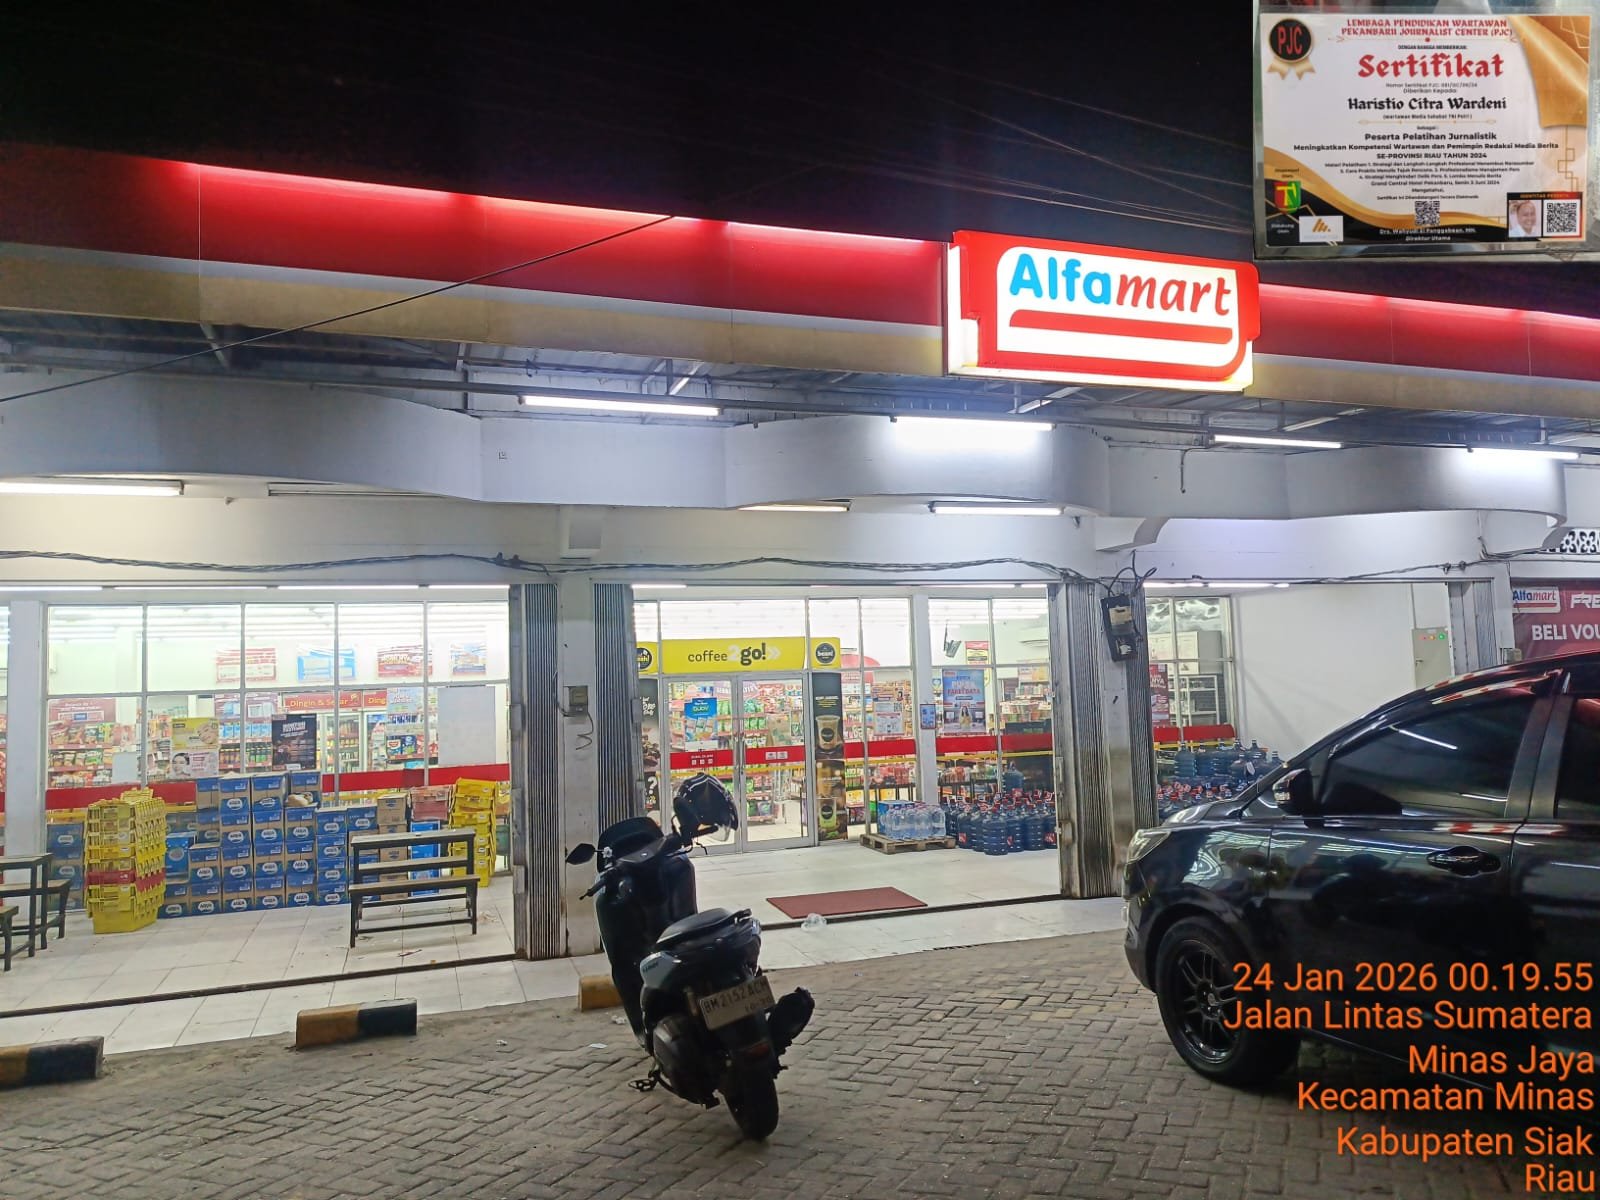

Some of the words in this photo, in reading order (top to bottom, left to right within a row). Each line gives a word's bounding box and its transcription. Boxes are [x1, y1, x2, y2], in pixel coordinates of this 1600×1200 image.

[1009, 253, 1232, 316] Alfamart
[1512, 590, 1556, 601] Alfamart
[1531, 624, 1568, 640] BELI
[687, 650, 728, 663] coffee
[740, 642, 766, 667] go!
[290, 700, 316, 708] Dingin
[326, 698, 348, 707] Sear
